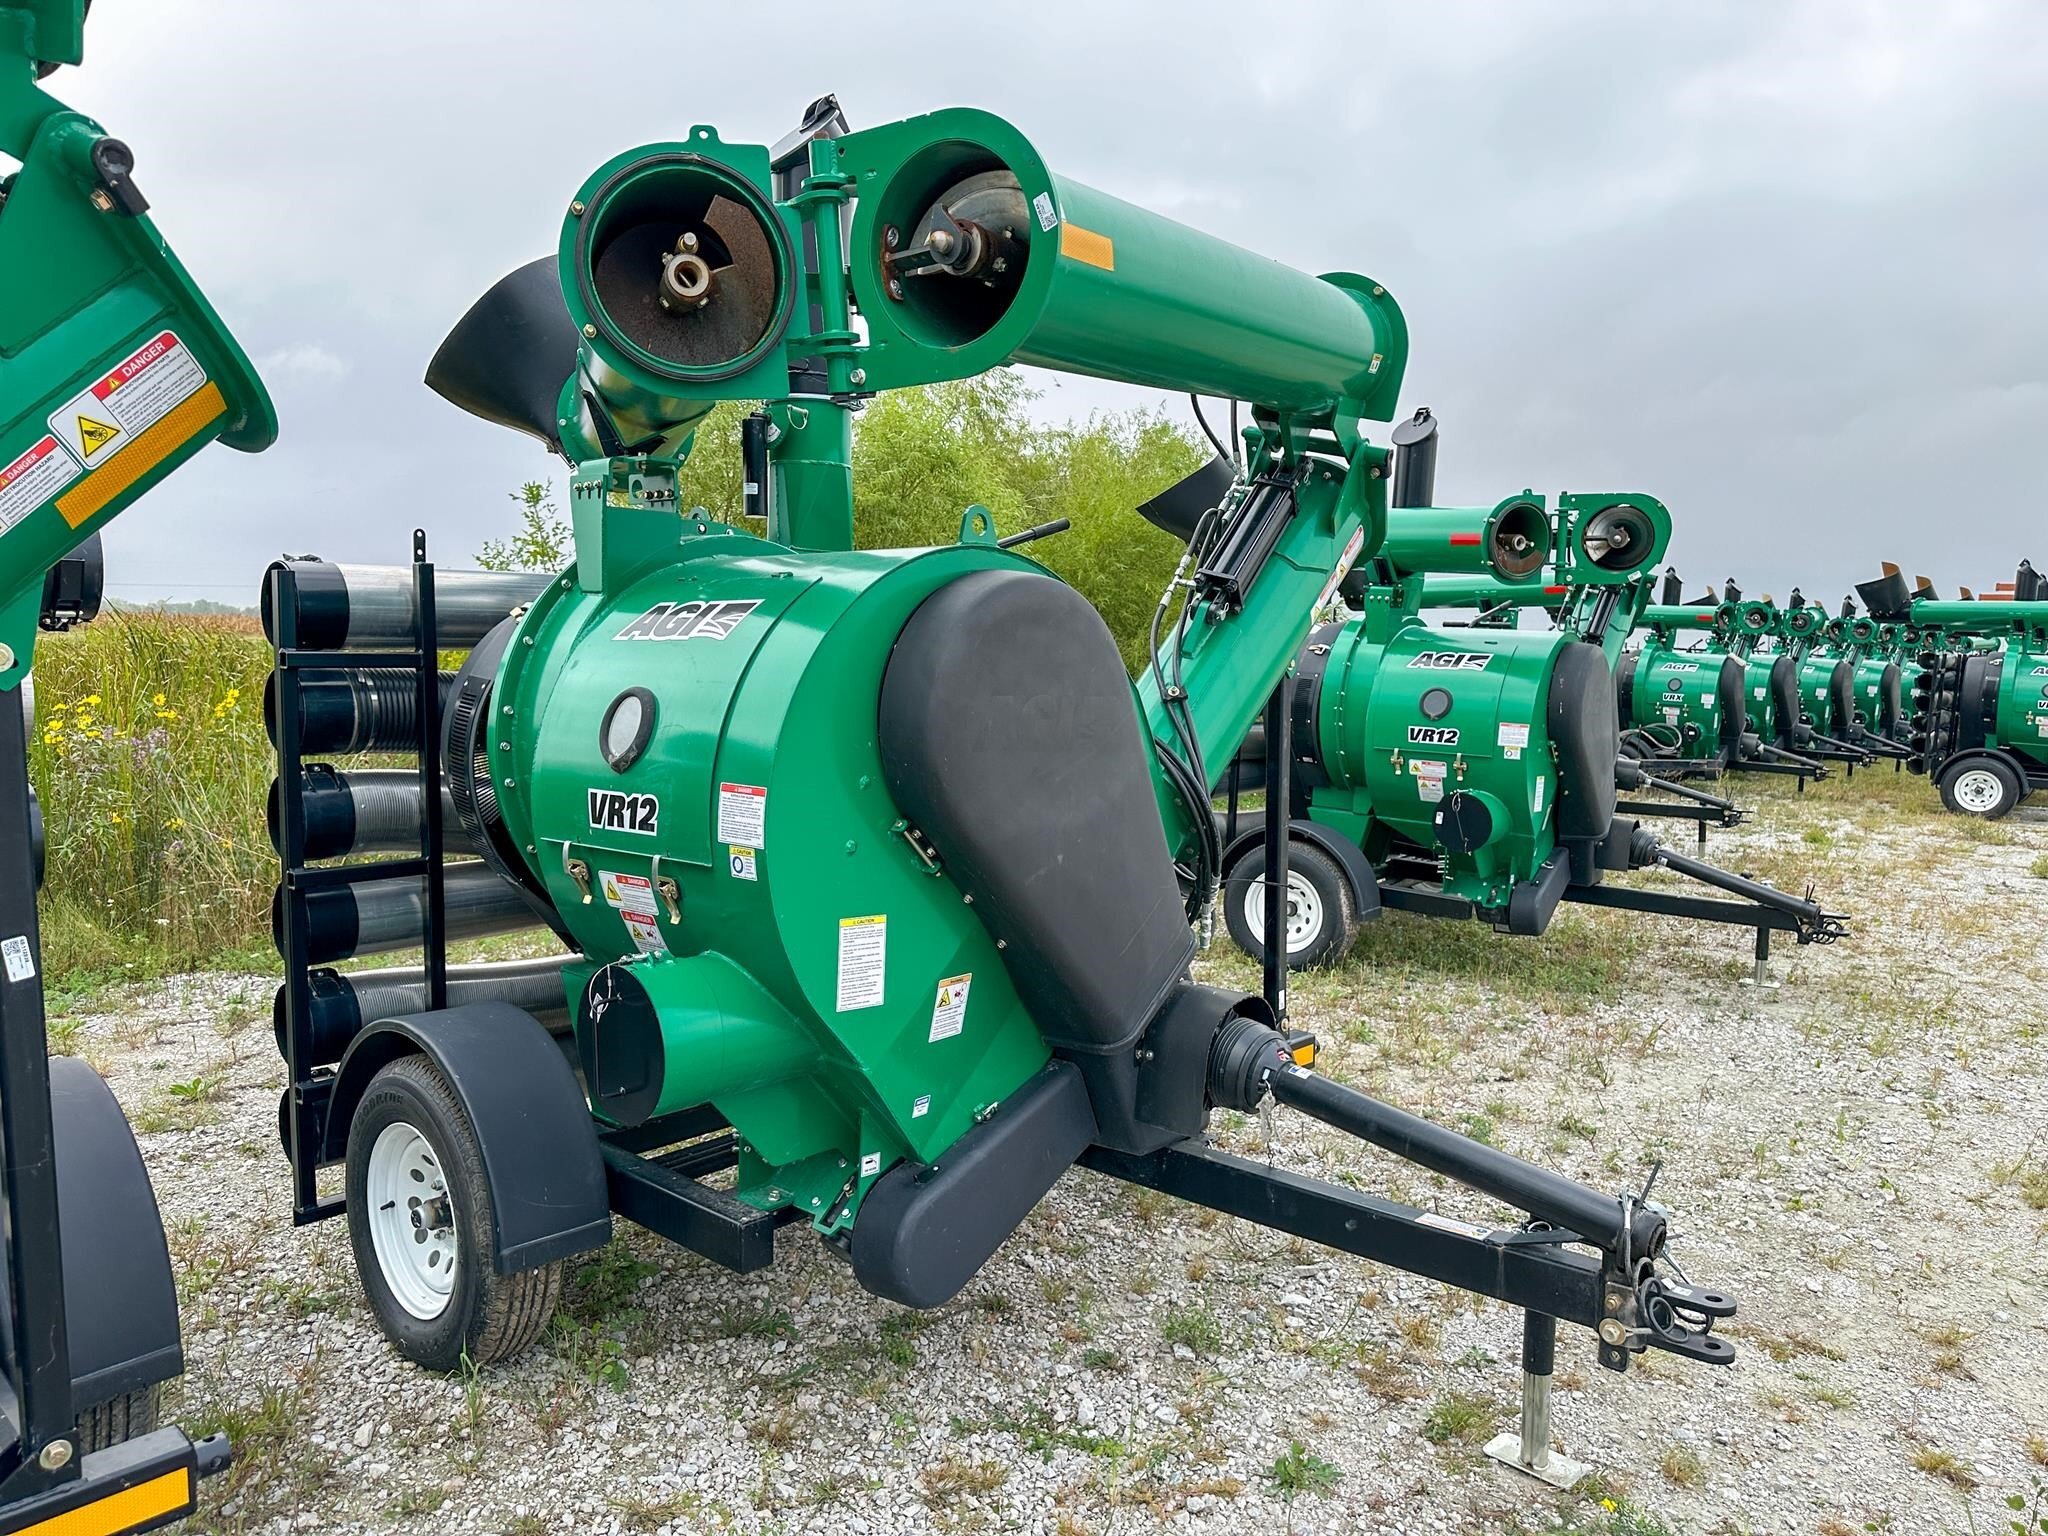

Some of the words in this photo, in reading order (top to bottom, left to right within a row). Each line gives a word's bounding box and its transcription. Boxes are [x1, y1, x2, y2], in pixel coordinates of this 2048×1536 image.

[121, 341, 166, 377] DANGER
[156, 353, 170, 365] PARTS
[5, 451, 40, 480] DANGER
[33, 453, 55, 471] HAZARD
[614, 600, 716, 639] AGI
[1410, 653, 1467, 669] AGI
[1409, 727, 1459, 744] VR12
[590, 791, 658, 833] VR12
[627, 878, 646, 886] DANGER
[630, 914, 652, 923] DANGER
[856, 918, 875, 926] CAUTION
